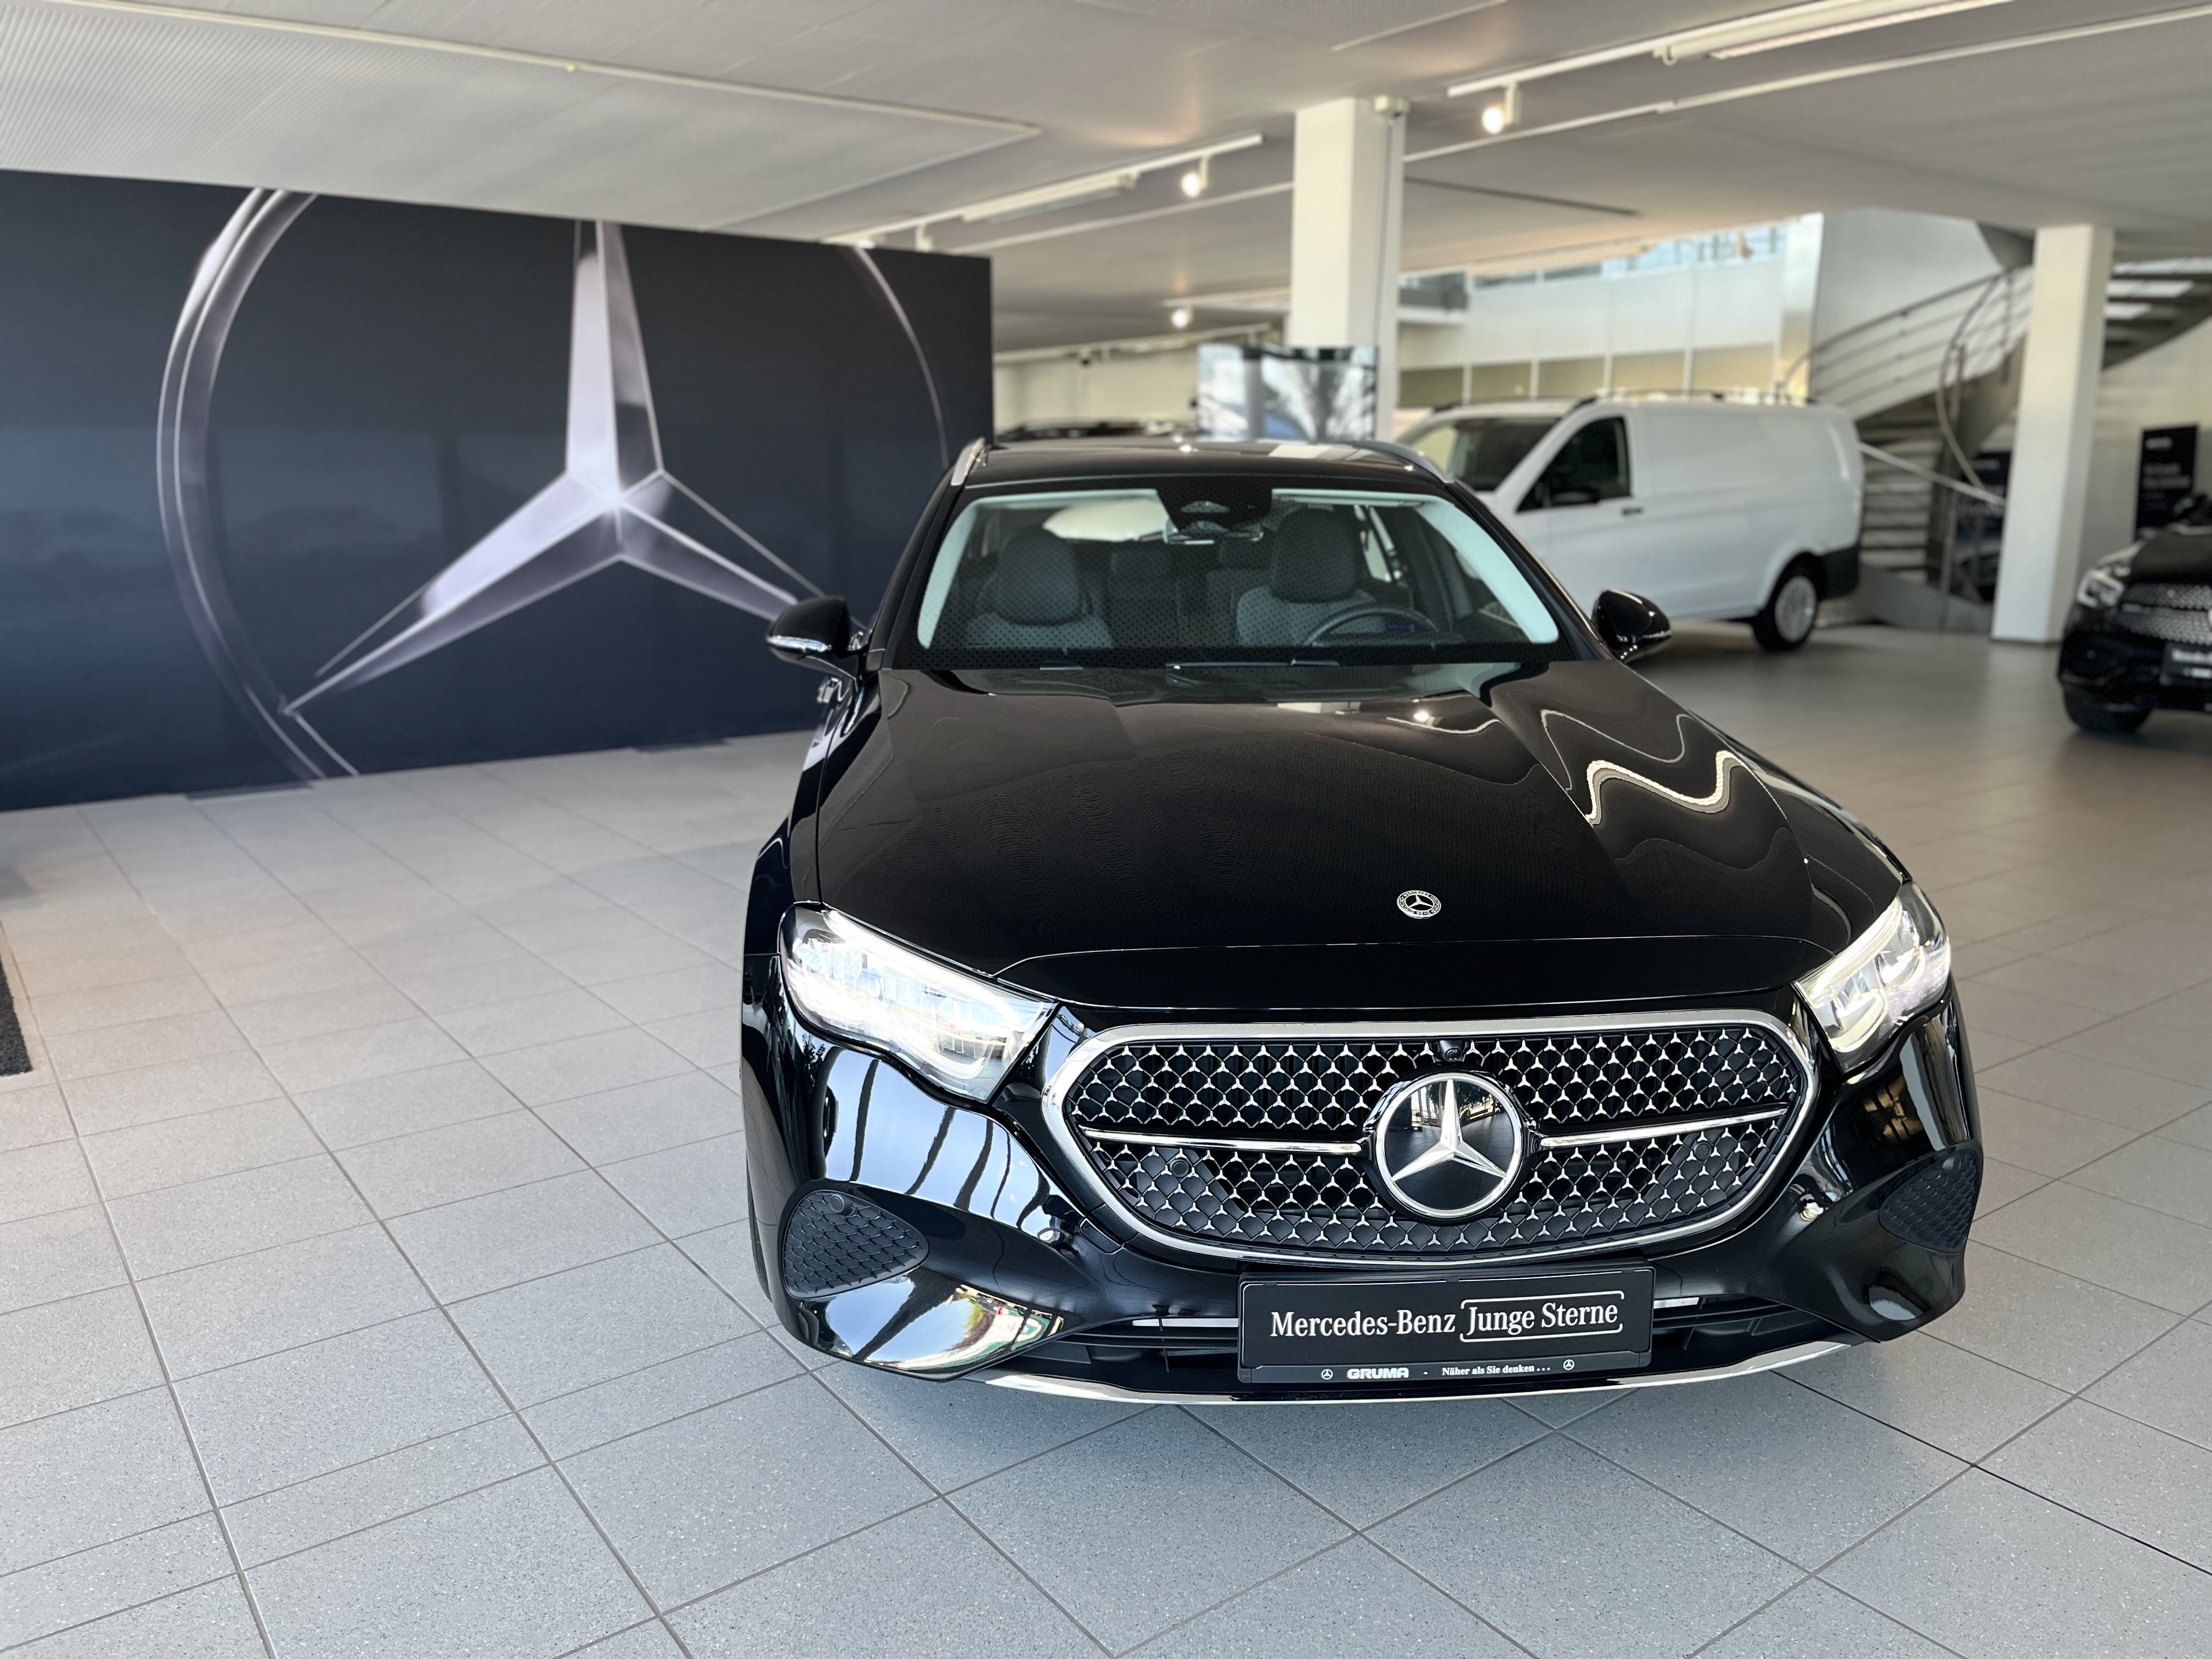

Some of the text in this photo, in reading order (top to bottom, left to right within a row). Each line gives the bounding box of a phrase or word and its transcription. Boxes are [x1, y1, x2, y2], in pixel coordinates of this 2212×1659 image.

[1270, 1302, 1618, 1337] Mercedes-Benz Junge Sterne
[1346, 1367, 1409, 1380] GRUMA
[1442, 1367, 1470, 1376] Näher
[1471, 1366, 1485, 1375] als
[1486, 1365, 1501, 1374] Sie
